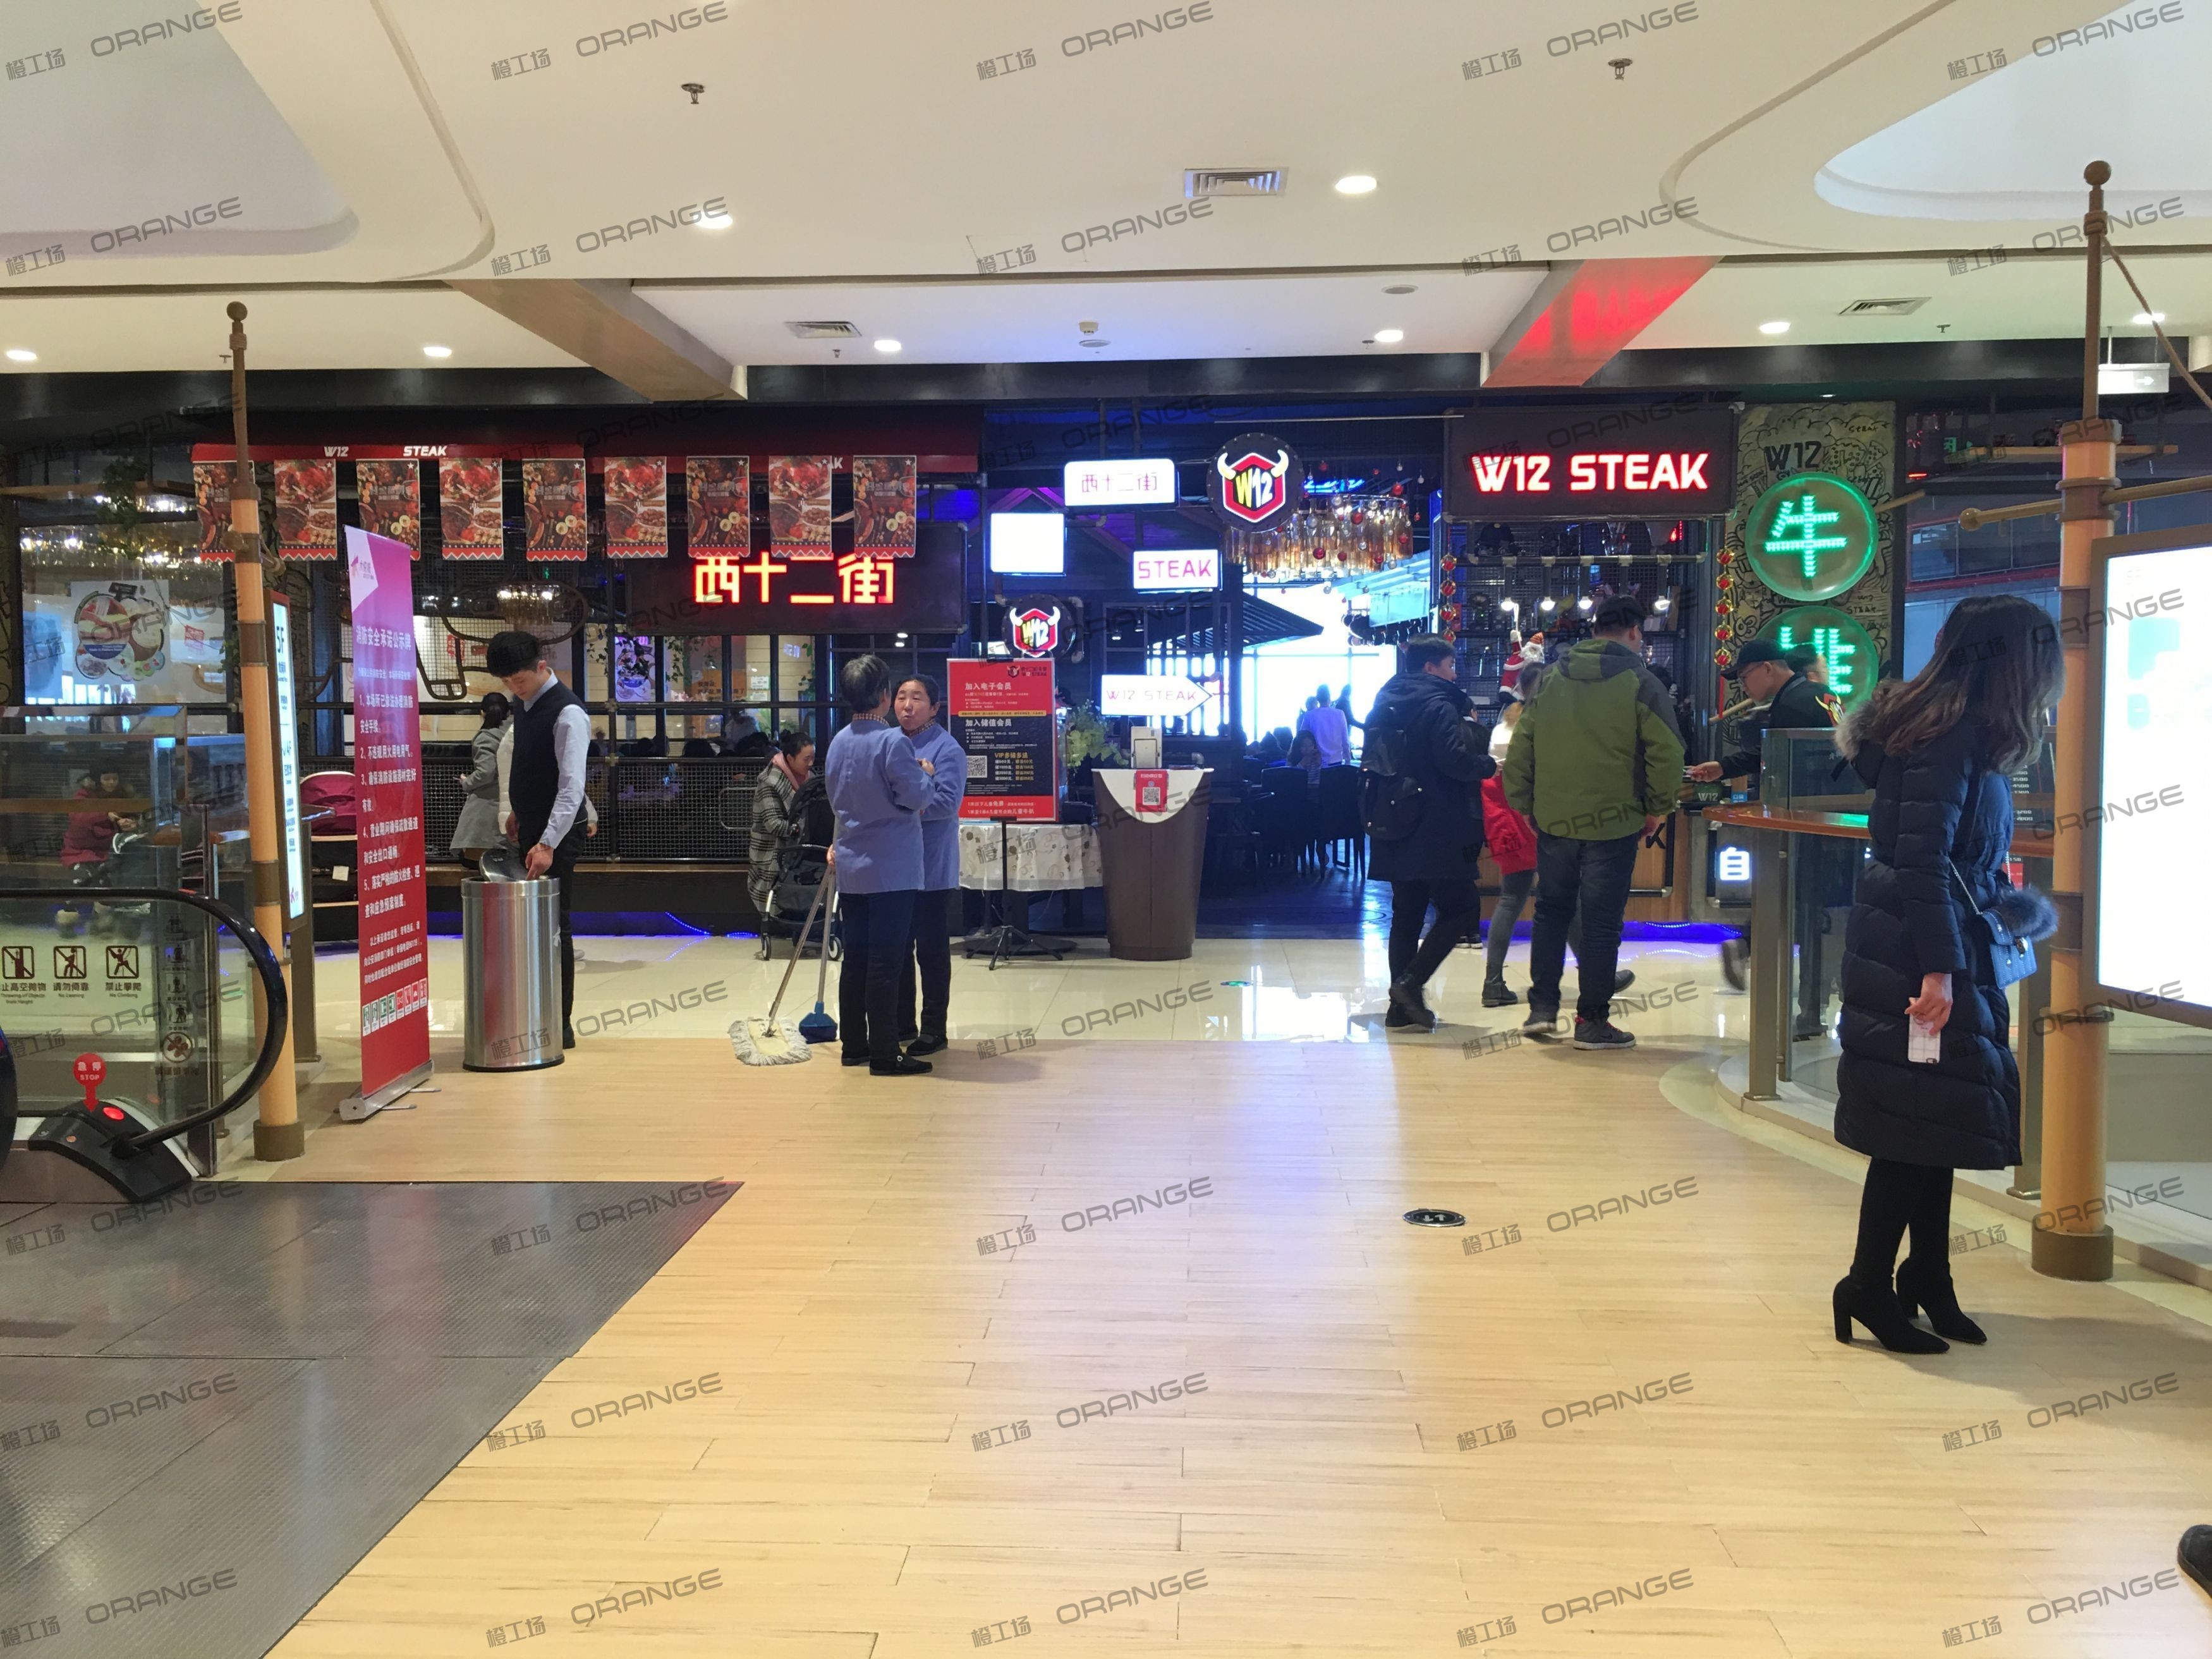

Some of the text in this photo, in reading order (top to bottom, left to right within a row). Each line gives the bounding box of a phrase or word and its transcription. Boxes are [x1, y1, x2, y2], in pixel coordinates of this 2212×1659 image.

[324, 446, 446, 457] W12 STEAK
[1764, 441, 1821, 471] W12
[1081, 472, 1158, 493] 西十二街
[1472, 454, 1551, 492] W12
[1570, 452, 1708, 490] STEAK
[1236, 468, 1273, 508] W12
[1763, 494, 1849, 578] 牛
[693, 552, 895, 605] 西十二街
[1138, 558, 1212, 579] STEAK
[276, 626, 284, 653] 5F
[356, 625, 411, 652] 消防安全承诺公示牌
[1022, 617, 1048, 647] W12
[965, 682, 1012, 691] 加入电子会员
[1106, 689, 1197, 702] W12 STEAK
[965, 719, 1012, 727] 加入储值会员
[53, 982, 90, 992] 请勿倚靠
[105, 982, 142, 992] 禁止攀爬
